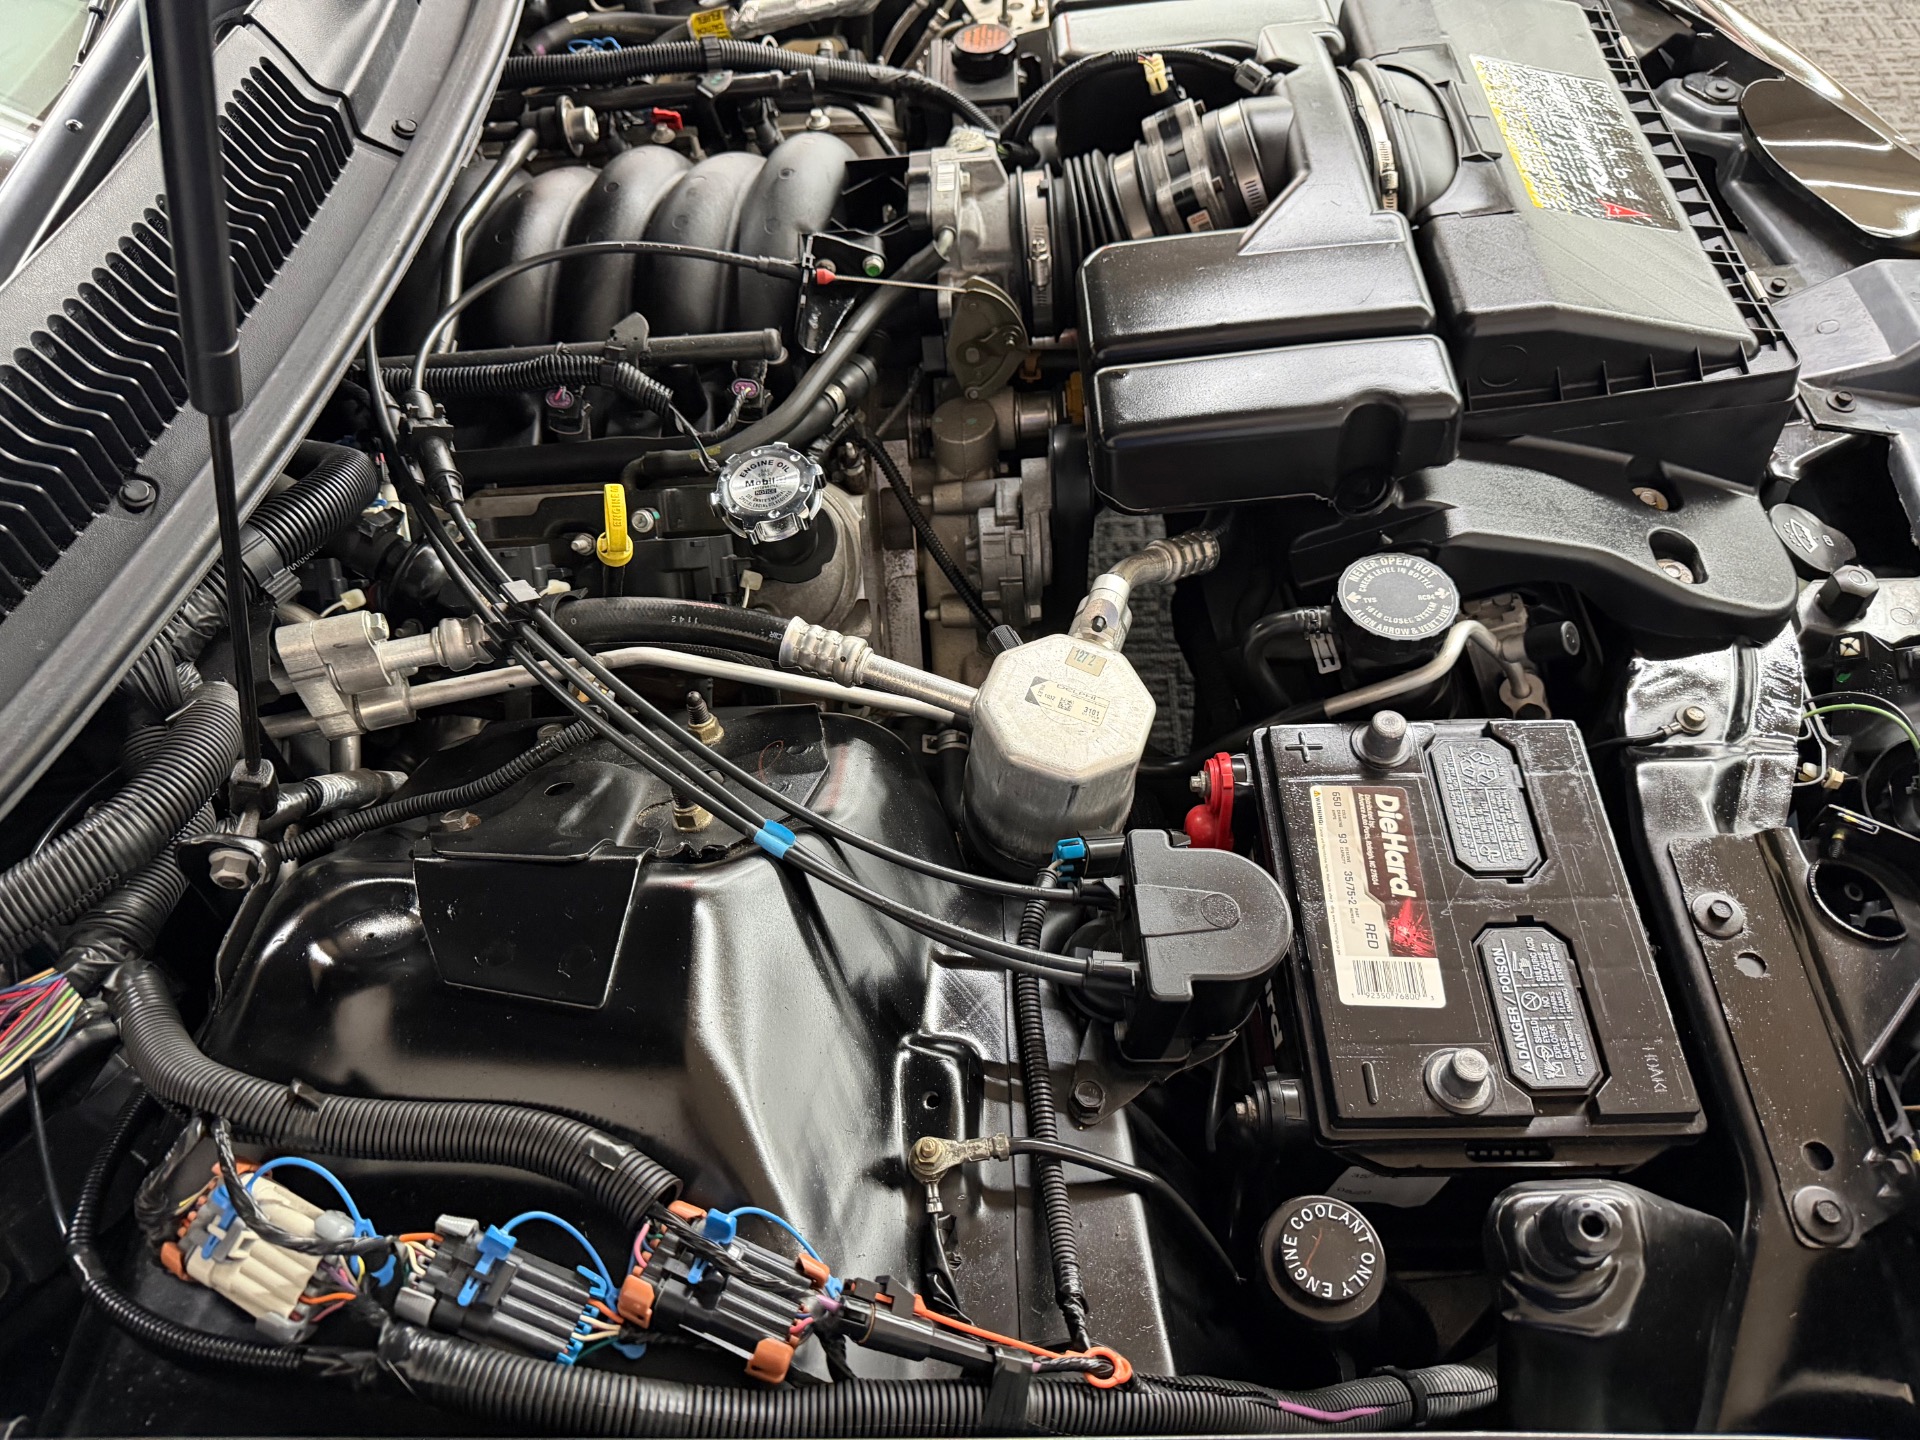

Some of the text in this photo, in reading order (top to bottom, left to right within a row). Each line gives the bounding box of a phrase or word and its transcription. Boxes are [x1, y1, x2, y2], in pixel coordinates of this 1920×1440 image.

[740, 460, 790, 478] ENGINE OIL
[1348, 557, 1438, 582] NEVER OPEN HOT
[1359, 574, 1375, 592] CHECK
[1374, 567, 1396, 577] LEVEL
[1408, 569, 1434, 589] BOTTLE
[1352, 609, 1377, 626] ALIGN
[1376, 624, 1410, 635] ARROW
[1419, 619, 1440, 633] VENT
[1438, 604, 1451, 622] TUBE
[1415, 601, 1437, 622] SYSTEM
[1332, 792, 1342, 806] 650
[1358, 794, 1367, 813] Advance
[1338, 834, 1347, 844] 93
[1374, 794, 1417, 898] DieHard
[1364, 923, 1379, 948] RED
[1492, 948, 1513, 993] POISON
[1526, 937, 1543, 981] SULFURIC ACID
[1538, 952, 1547, 969] CAUSE
[1549, 943, 1563, 980] SEVERE BURNS
[1542, 997, 1550, 1007] NO
[1549, 992, 1559, 1012] SPARKS
[1555, 992, 1565, 1012] FLAMES
[1562, 988, 1573, 1012] SMOKING
[1507, 1007, 1530, 1060] DANGER
[1530, 1021, 1542, 1043] SHIELD
[1540, 1027, 1550, 1043] EYES
[1548, 1025, 1562, 1058] EXPLOSIVE
[1560, 1037, 1571, 1058] GASES
[1282, 1204, 1376, 1298] ENGINE COOLANT ONLY
